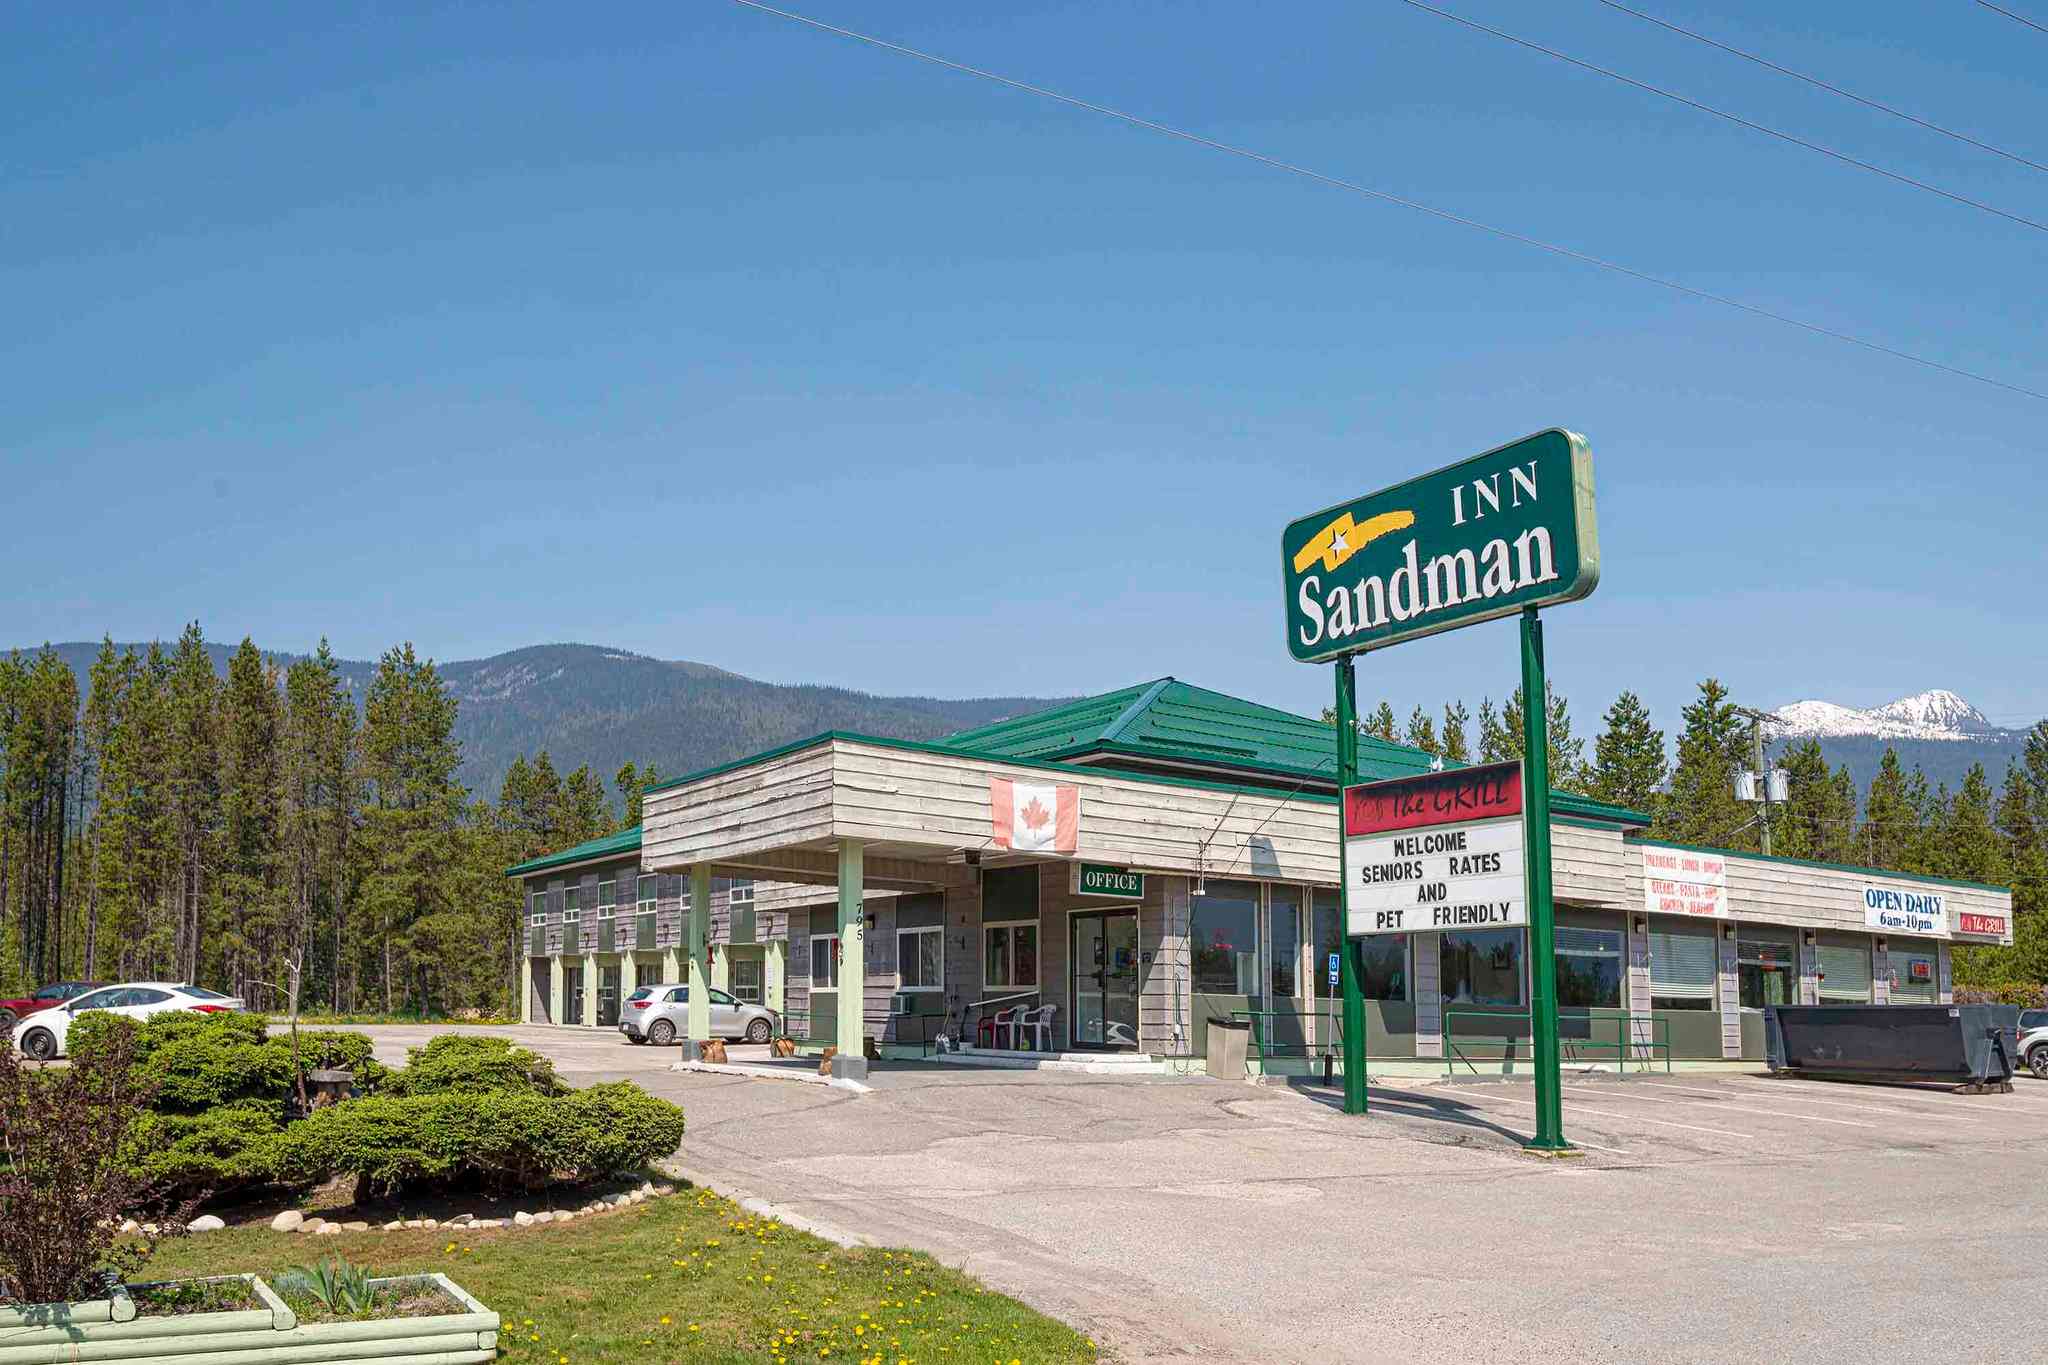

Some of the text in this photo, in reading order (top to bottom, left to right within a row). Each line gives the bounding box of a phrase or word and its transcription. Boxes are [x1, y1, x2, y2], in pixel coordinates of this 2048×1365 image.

[1450, 461, 1538, 527] INN
[1299, 526, 1558, 646] Sandman
[1394, 792, 1424, 817] The
[1394, 832, 1467, 857] WELCOME
[1086, 871, 1137, 890] OFFICE
[1362, 852, 1501, 884] SENIORS RATES
[1417, 882, 1447, 903] AND
[1866, 888, 1942, 915] OPEN DAILY
[1376, 902, 1511, 929] PET FRIENDLY
